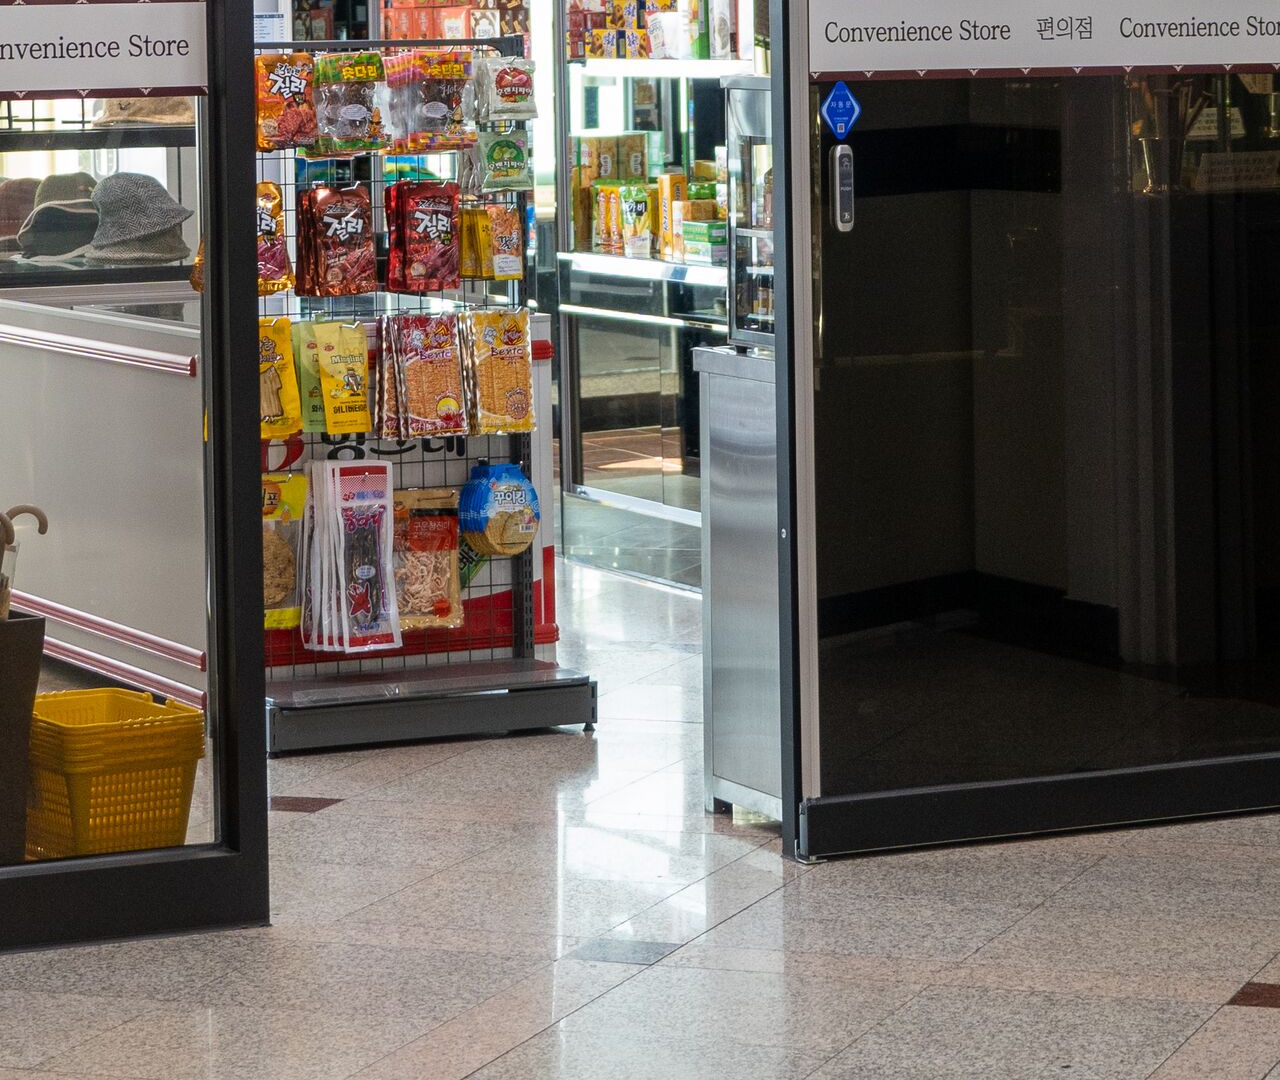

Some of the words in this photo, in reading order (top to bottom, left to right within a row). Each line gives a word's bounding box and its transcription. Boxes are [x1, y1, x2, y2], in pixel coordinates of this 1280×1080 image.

[825, 20, 953, 43] Convenience
[959, 19, 1011, 41] Store
[1036, 15, 1093, 41] 편의점
[1120, 16, 1240, 38] Convenience
[128, 34, 190, 58] Store
[342, 65, 377, 81] 숏다리
[431, 62, 465, 78] 숏다리
[269, 72, 307, 99] 질러
[322, 215, 364, 241] 질러
[414, 210, 452, 240] 질러
[419, 349, 452, 361] Bento
[490, 346, 525, 358] Bento
[494, 489, 527, 505] 꾸이킹
